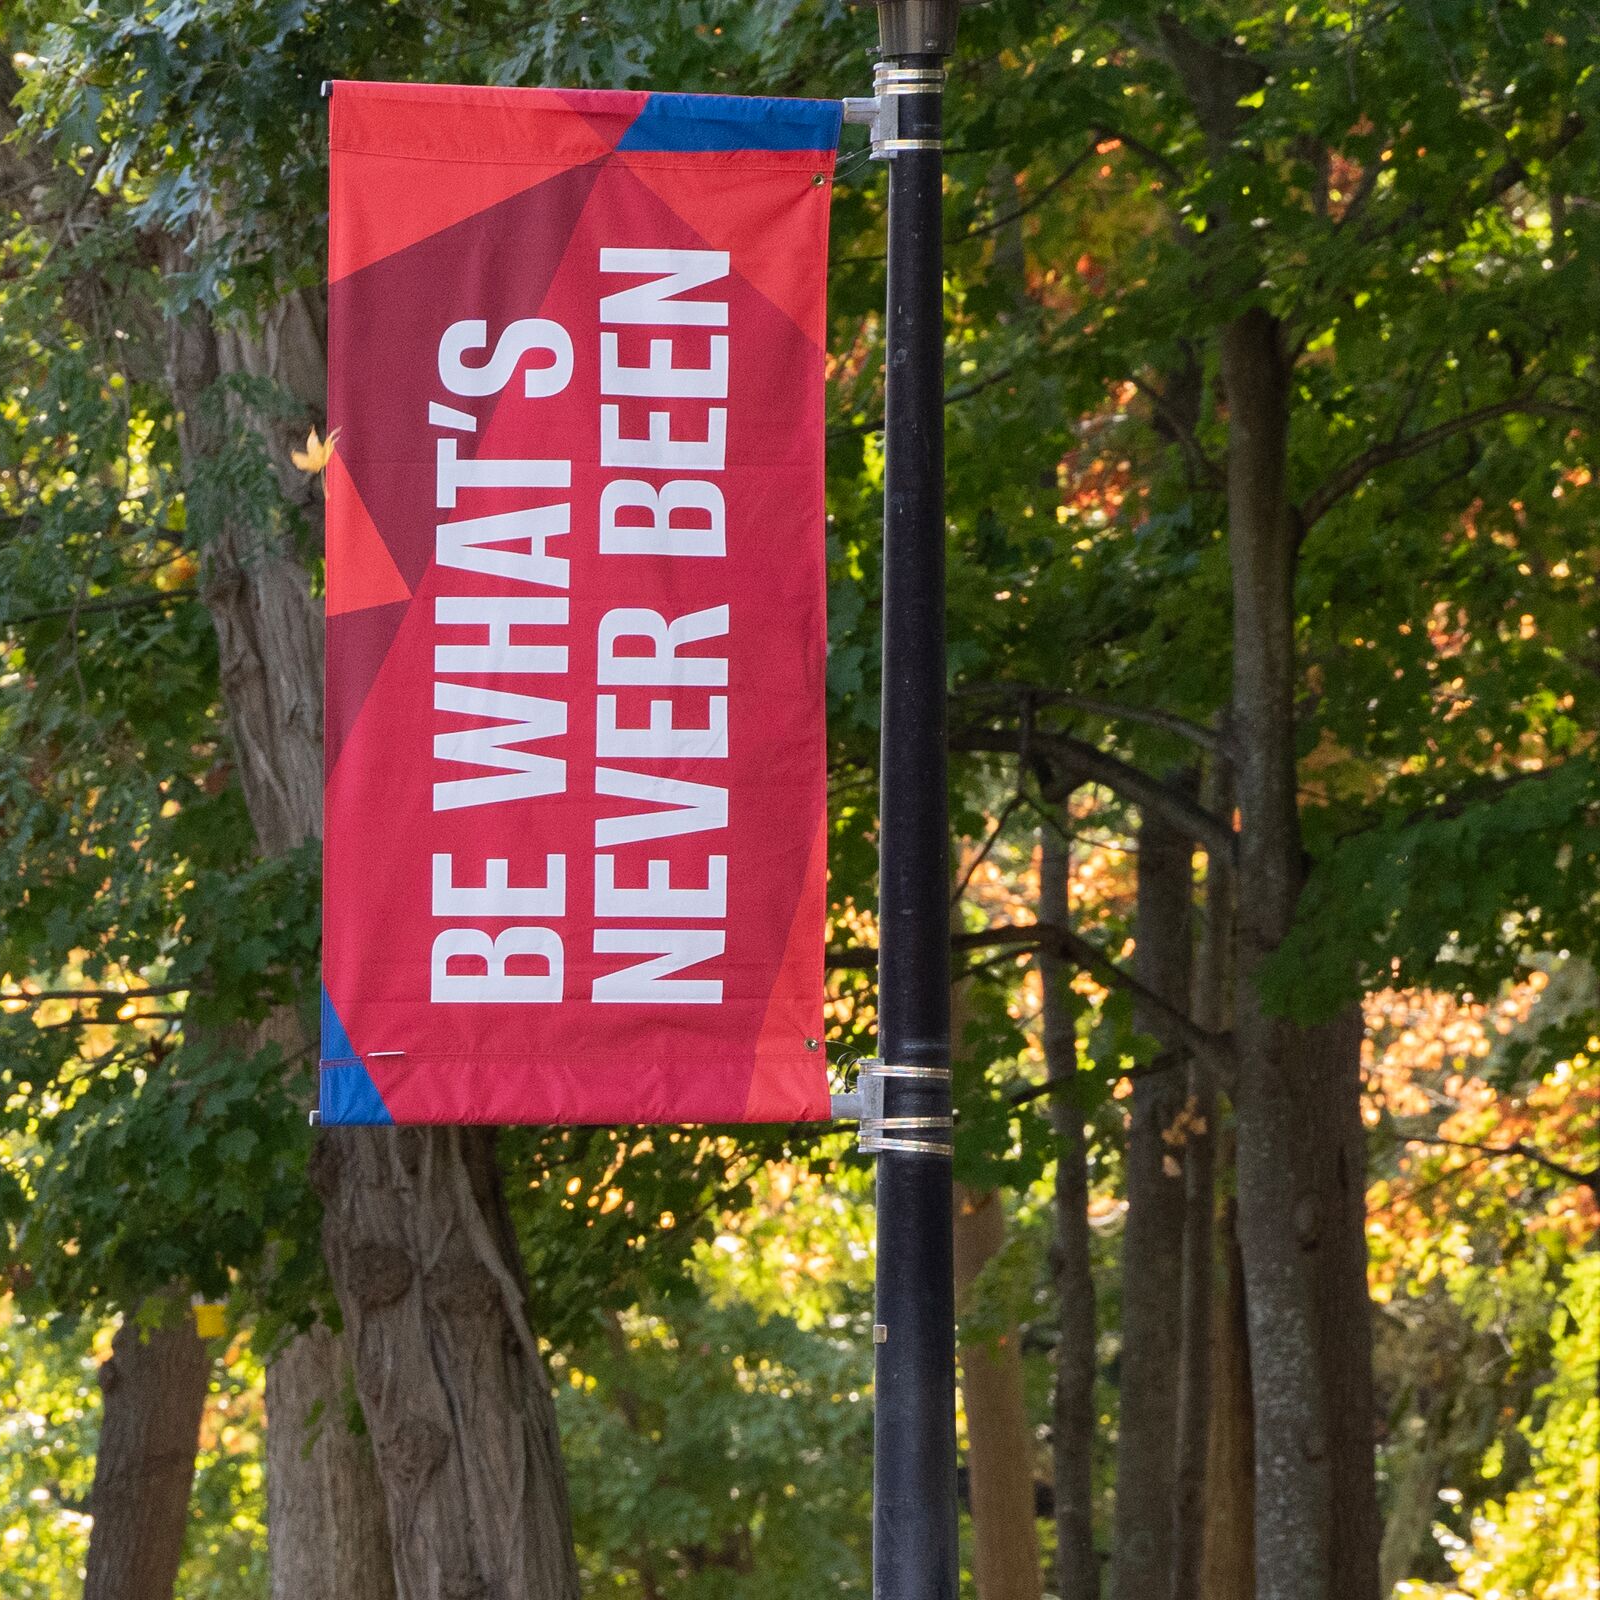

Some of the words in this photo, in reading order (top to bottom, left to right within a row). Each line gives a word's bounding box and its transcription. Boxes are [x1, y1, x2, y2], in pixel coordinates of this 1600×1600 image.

[428, 318, 575, 812] WHAT'S
[598, 247, 731, 558] BEEN
[430, 853, 567, 1004] BE
[591, 603, 730, 1004] NEVER
